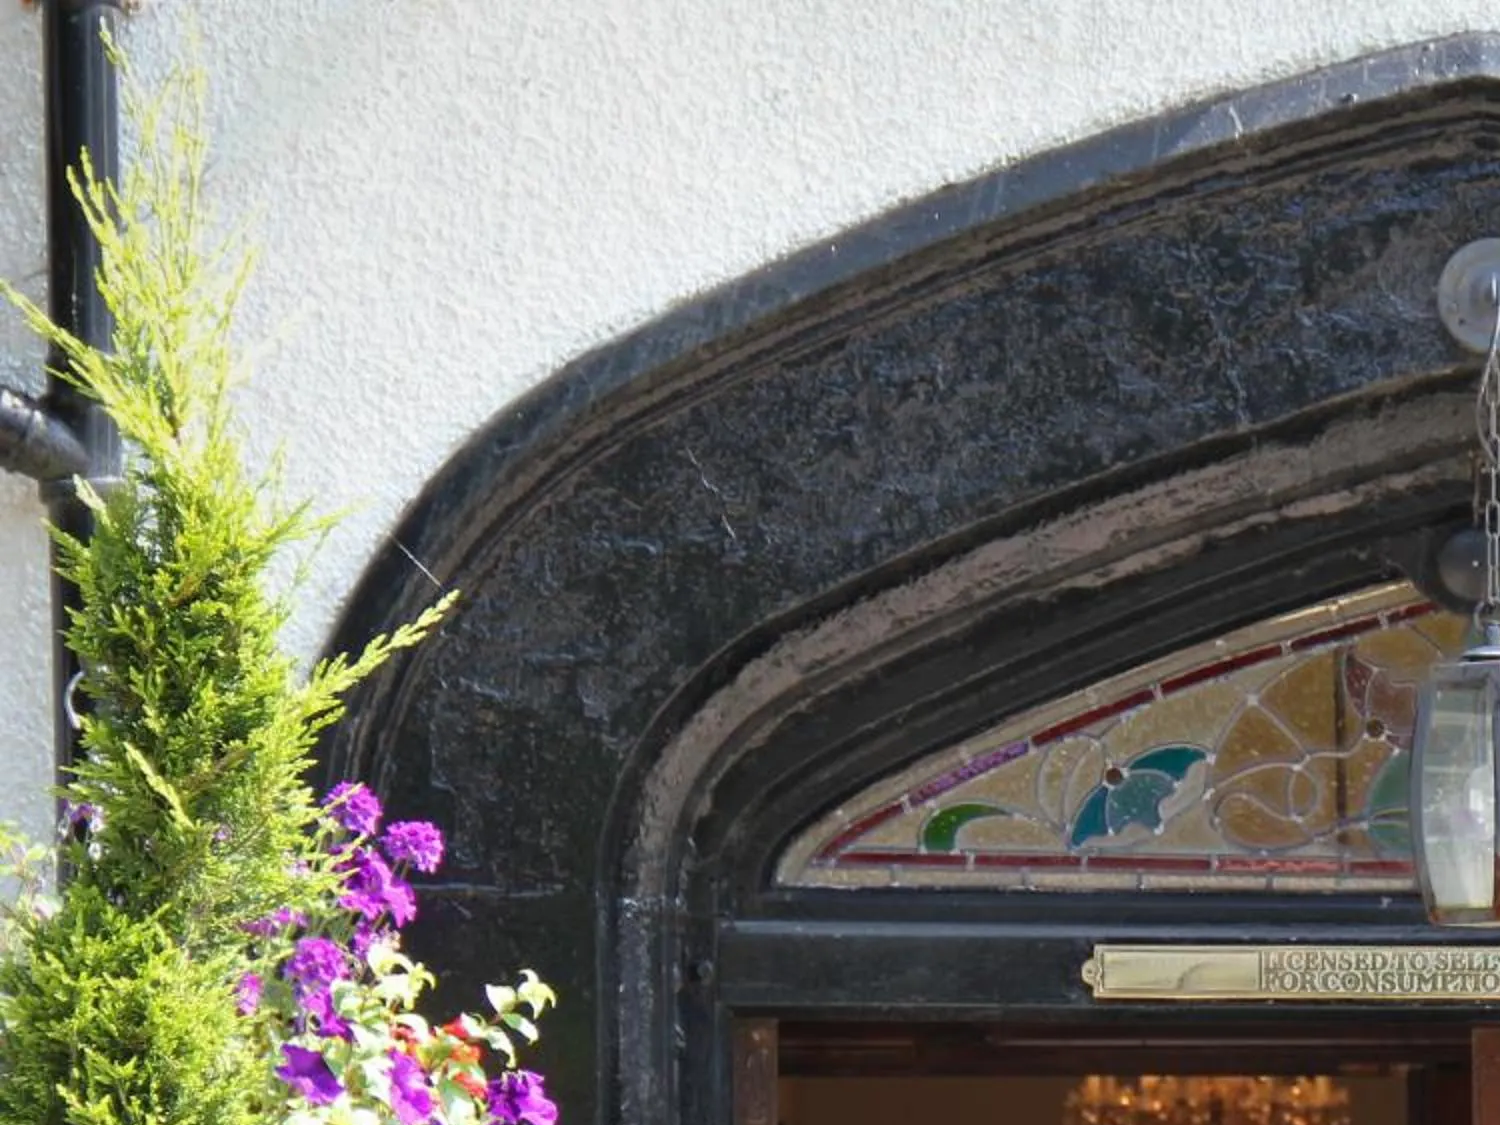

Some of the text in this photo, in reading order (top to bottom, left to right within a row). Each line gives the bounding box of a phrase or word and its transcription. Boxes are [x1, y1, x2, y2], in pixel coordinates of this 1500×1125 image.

[1263, 952, 1388, 971] LICENSED
[1393, 952, 1431, 971] TO
[1263, 972, 1314, 992] FOR
